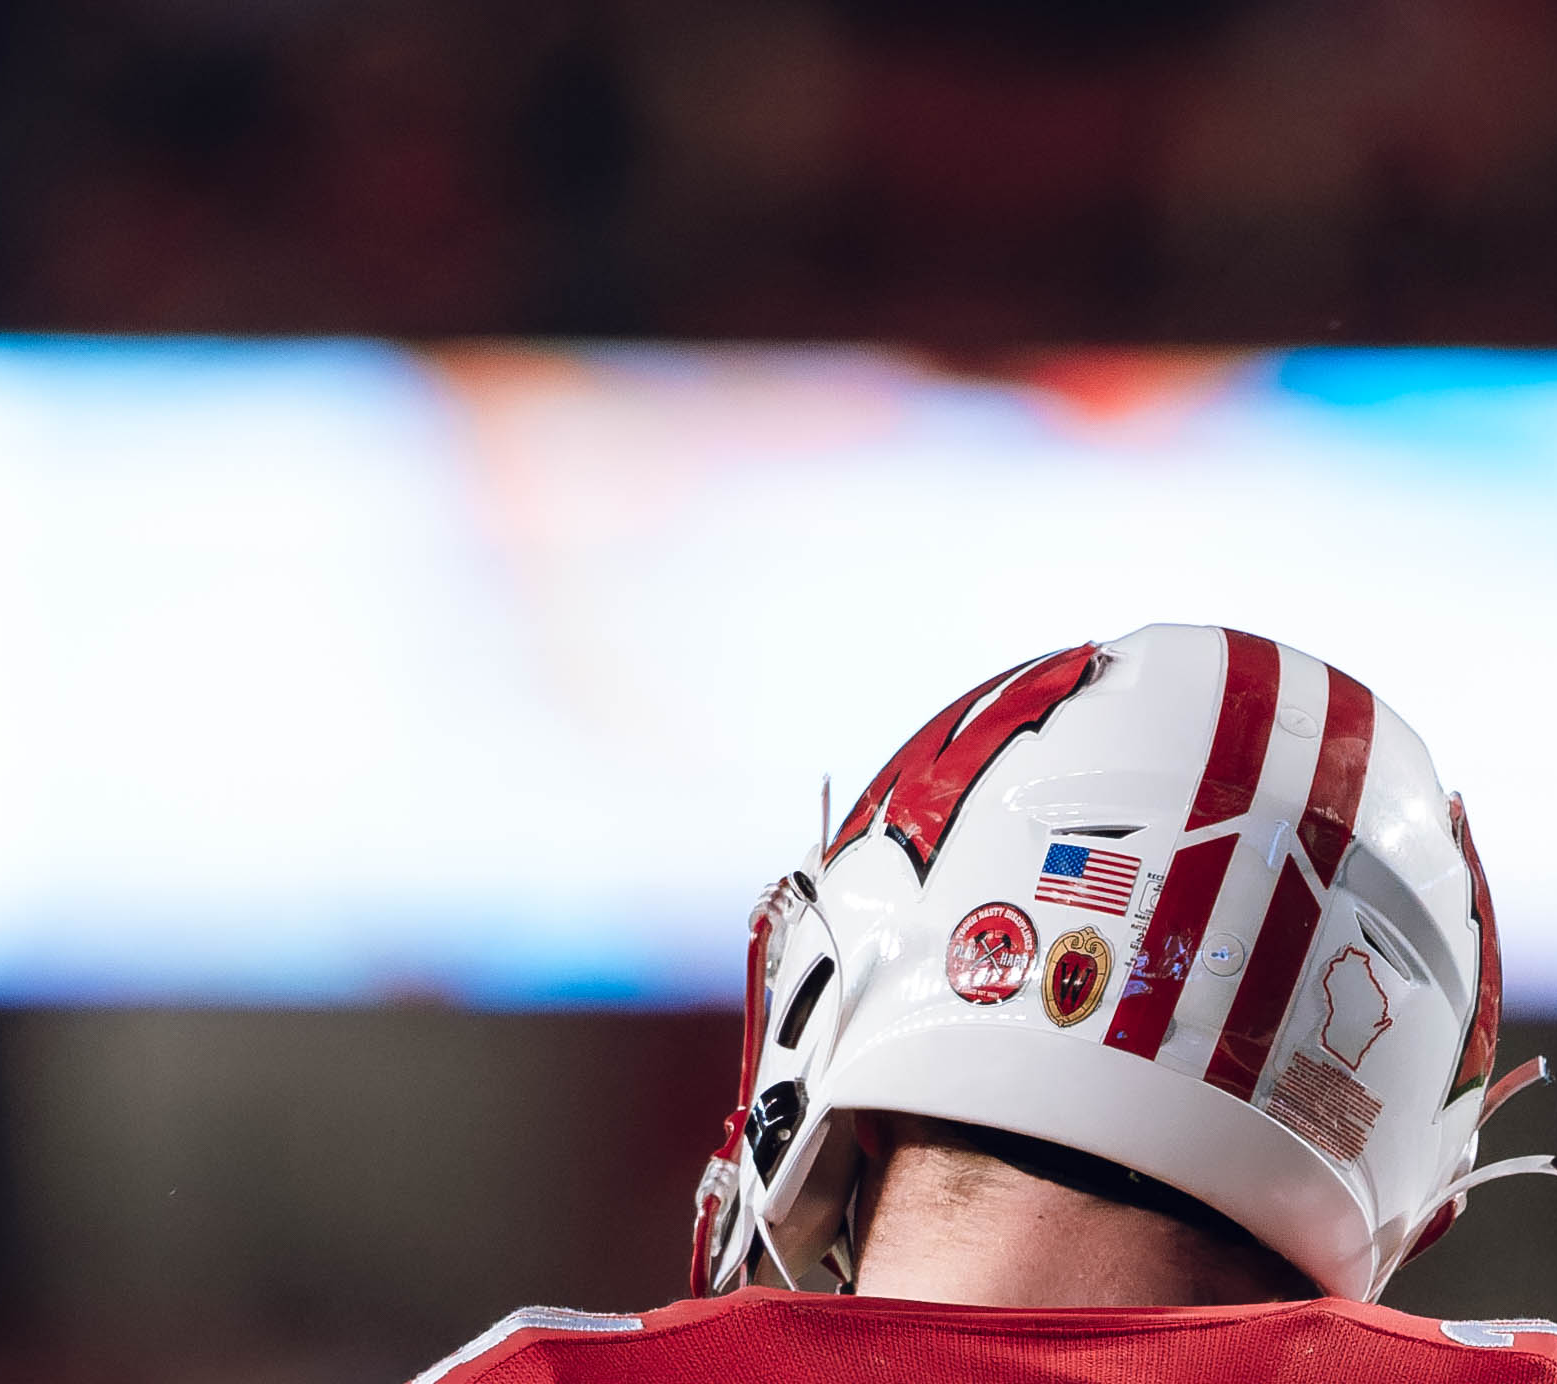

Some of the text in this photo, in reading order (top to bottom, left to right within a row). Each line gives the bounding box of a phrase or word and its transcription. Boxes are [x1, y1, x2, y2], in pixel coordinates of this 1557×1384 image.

[978, 907, 1006, 921] NASTY
[953, 944, 979, 960] PLAY
[1059, 960, 1093, 1009] W
